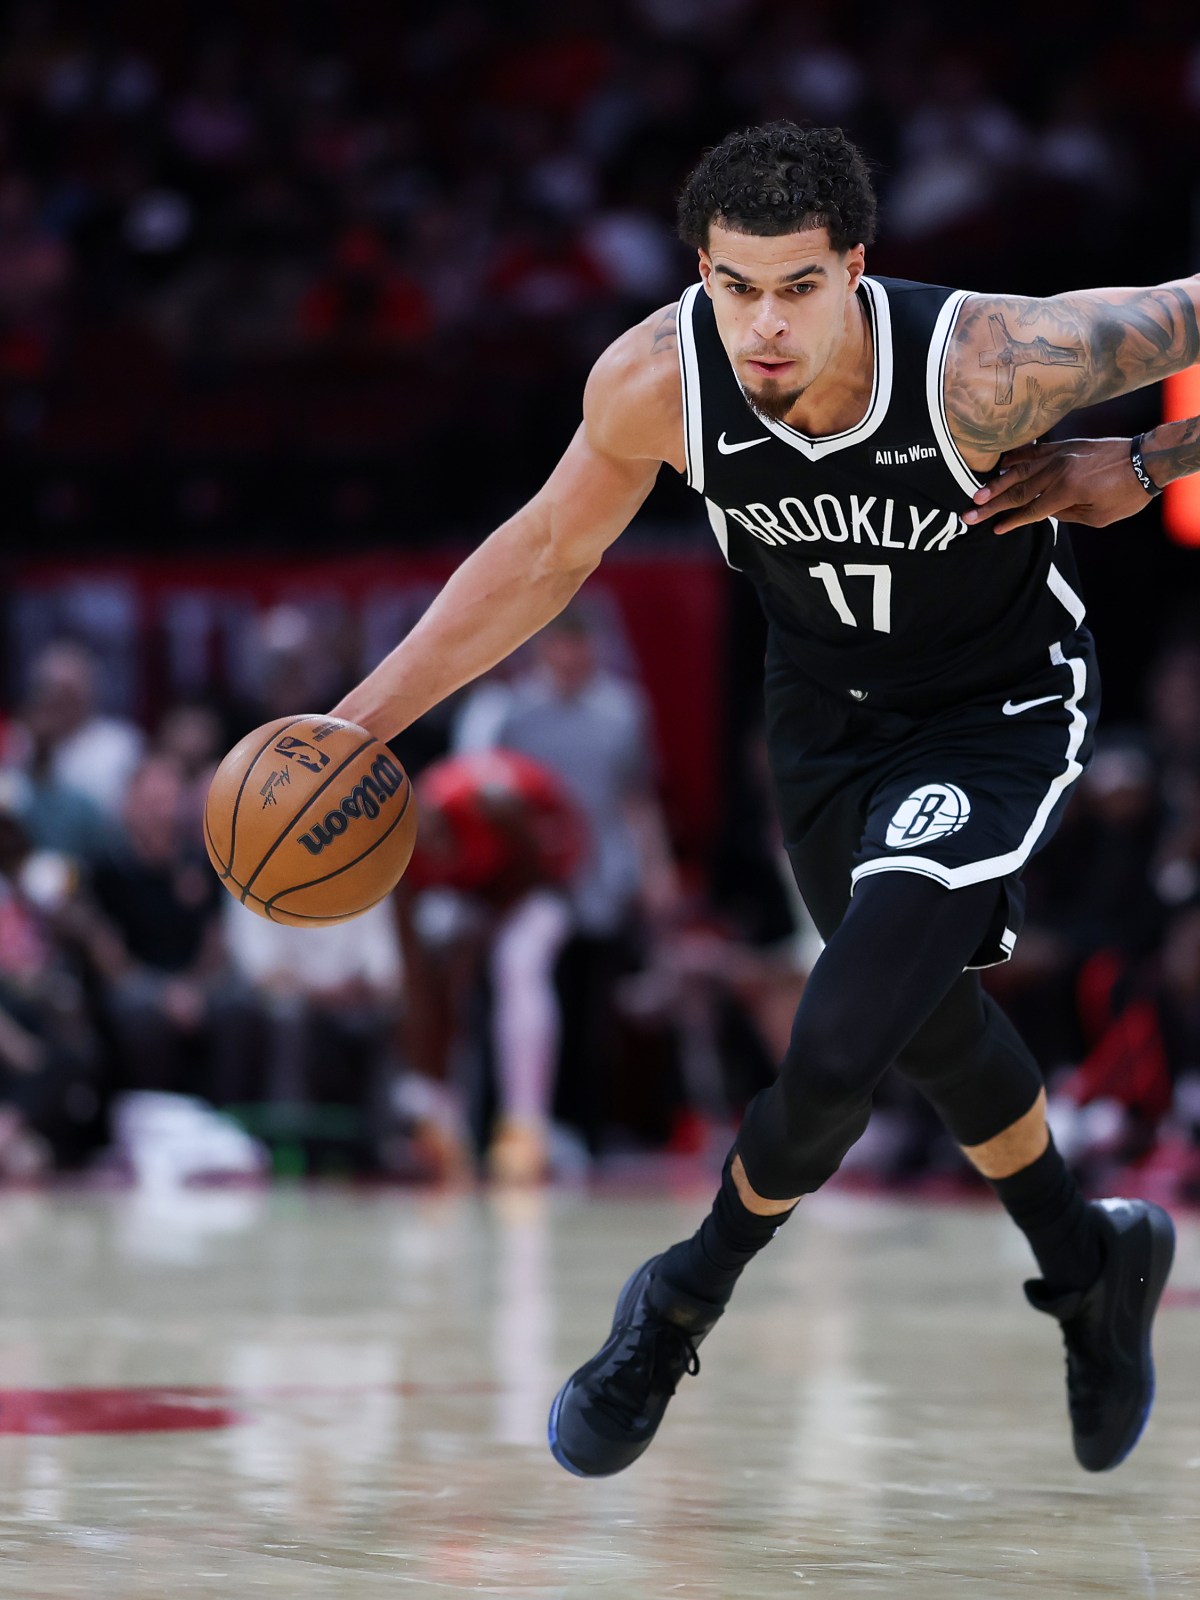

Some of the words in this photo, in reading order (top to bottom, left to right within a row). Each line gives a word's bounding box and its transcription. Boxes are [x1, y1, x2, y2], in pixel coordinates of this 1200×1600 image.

[875, 450, 893, 465] All
[894, 450, 908, 465] In
[908, 444, 937, 462] Won
[726, 493, 969, 552] BROOKLYN
[808, 561, 892, 634] 17
[297, 753, 404, 856] Wilson
